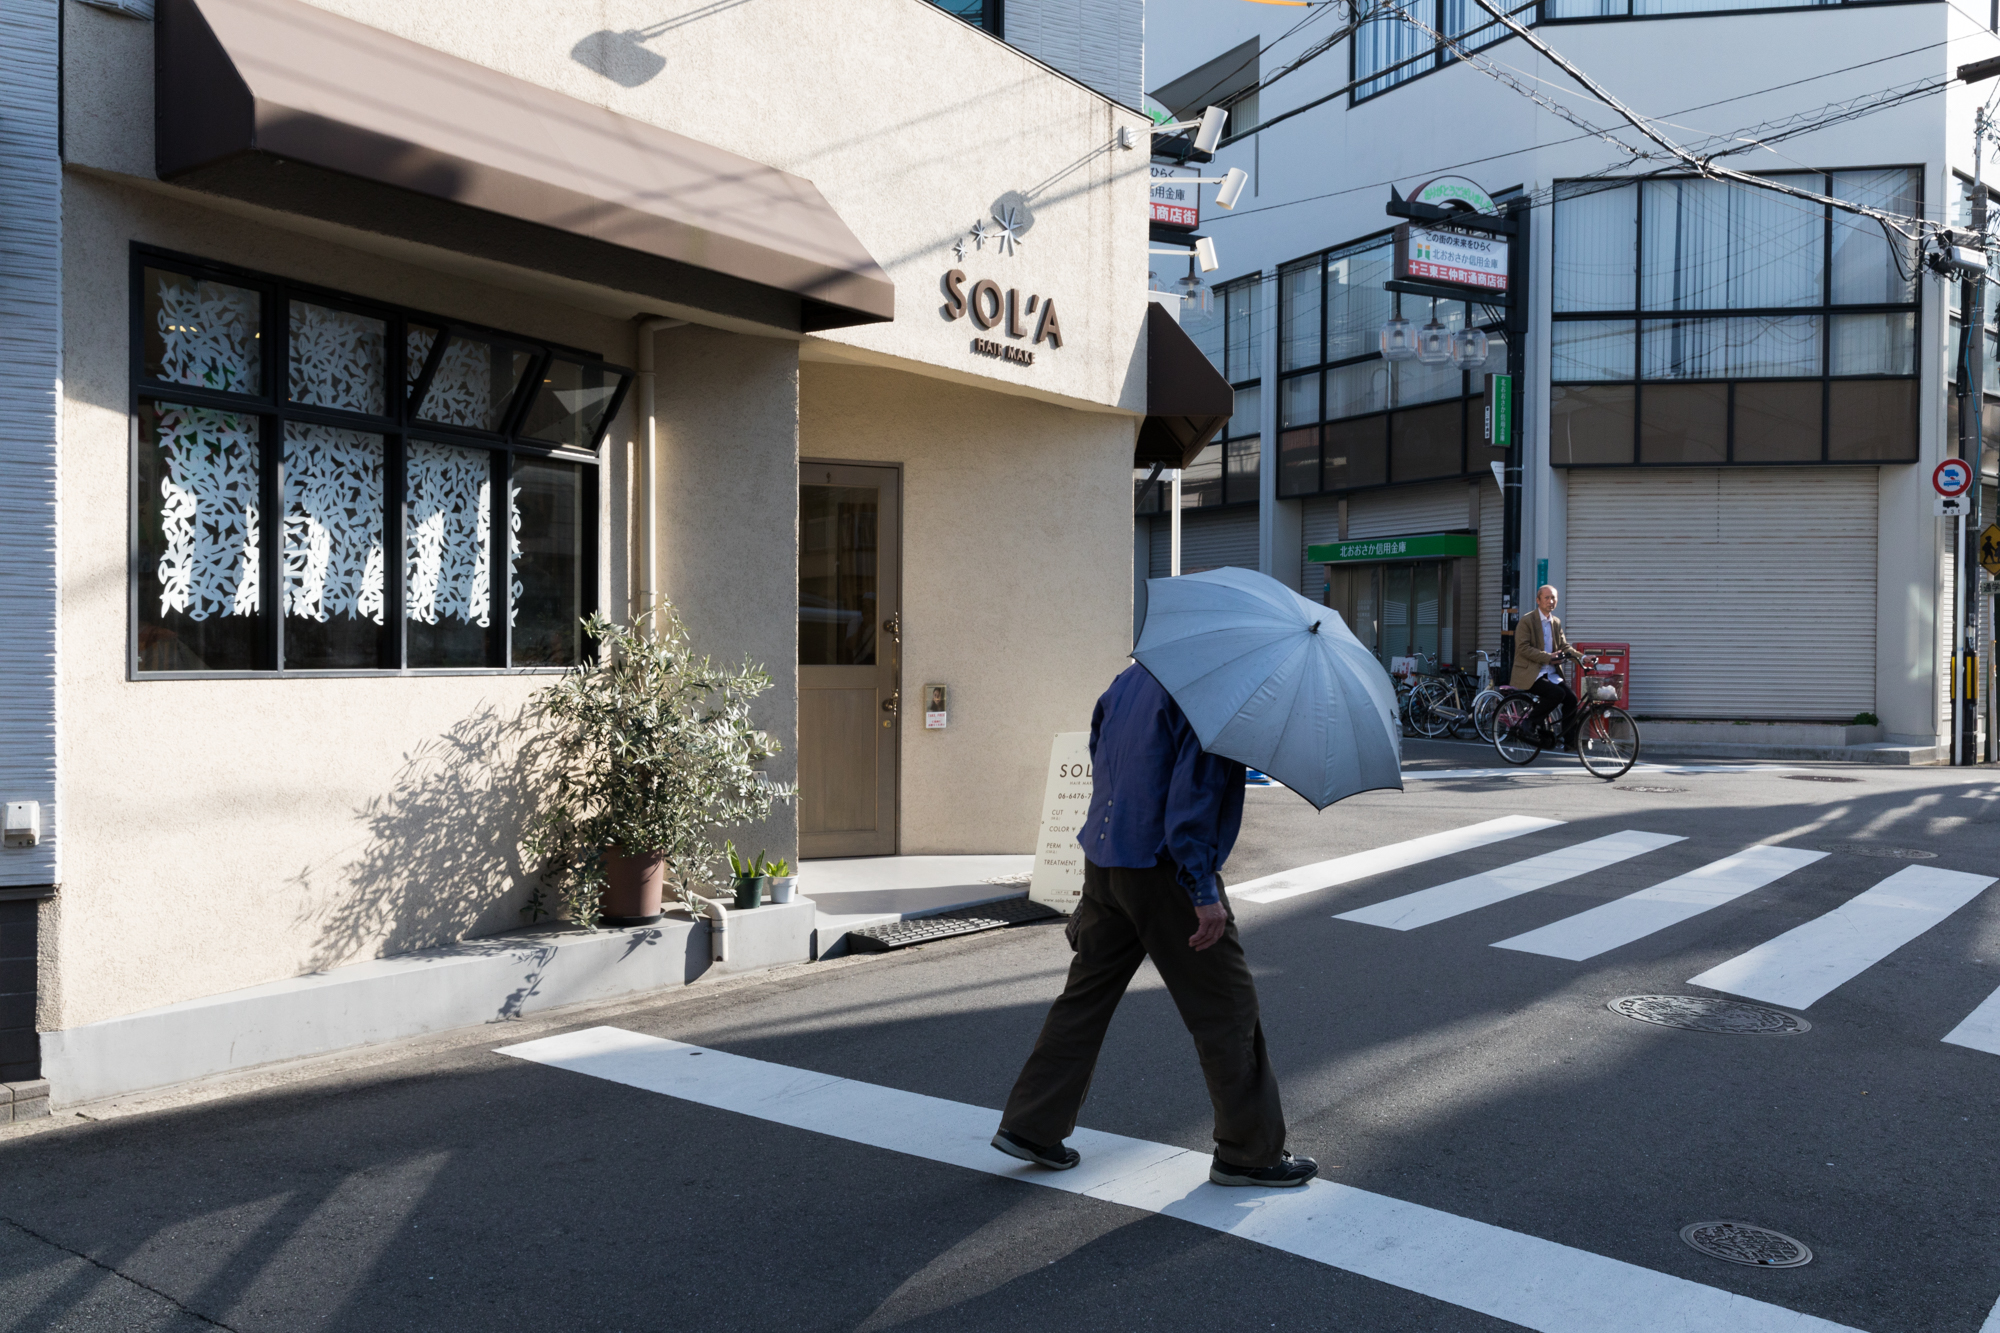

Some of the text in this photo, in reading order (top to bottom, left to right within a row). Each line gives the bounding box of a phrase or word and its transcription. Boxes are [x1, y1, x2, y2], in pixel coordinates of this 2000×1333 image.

[1426, 232, 1491, 252] この街の未来をひらく
[1432, 249, 1498, 269] 北おおさか信用金庫
[1409, 261, 1507, 289] 十三東三仲町通商店街
[975, 338, 1036, 365] HAIR MAKE
[1340, 541, 1407, 557] 北おおさか信用金庫
[1059, 763, 1092, 778] SOL
